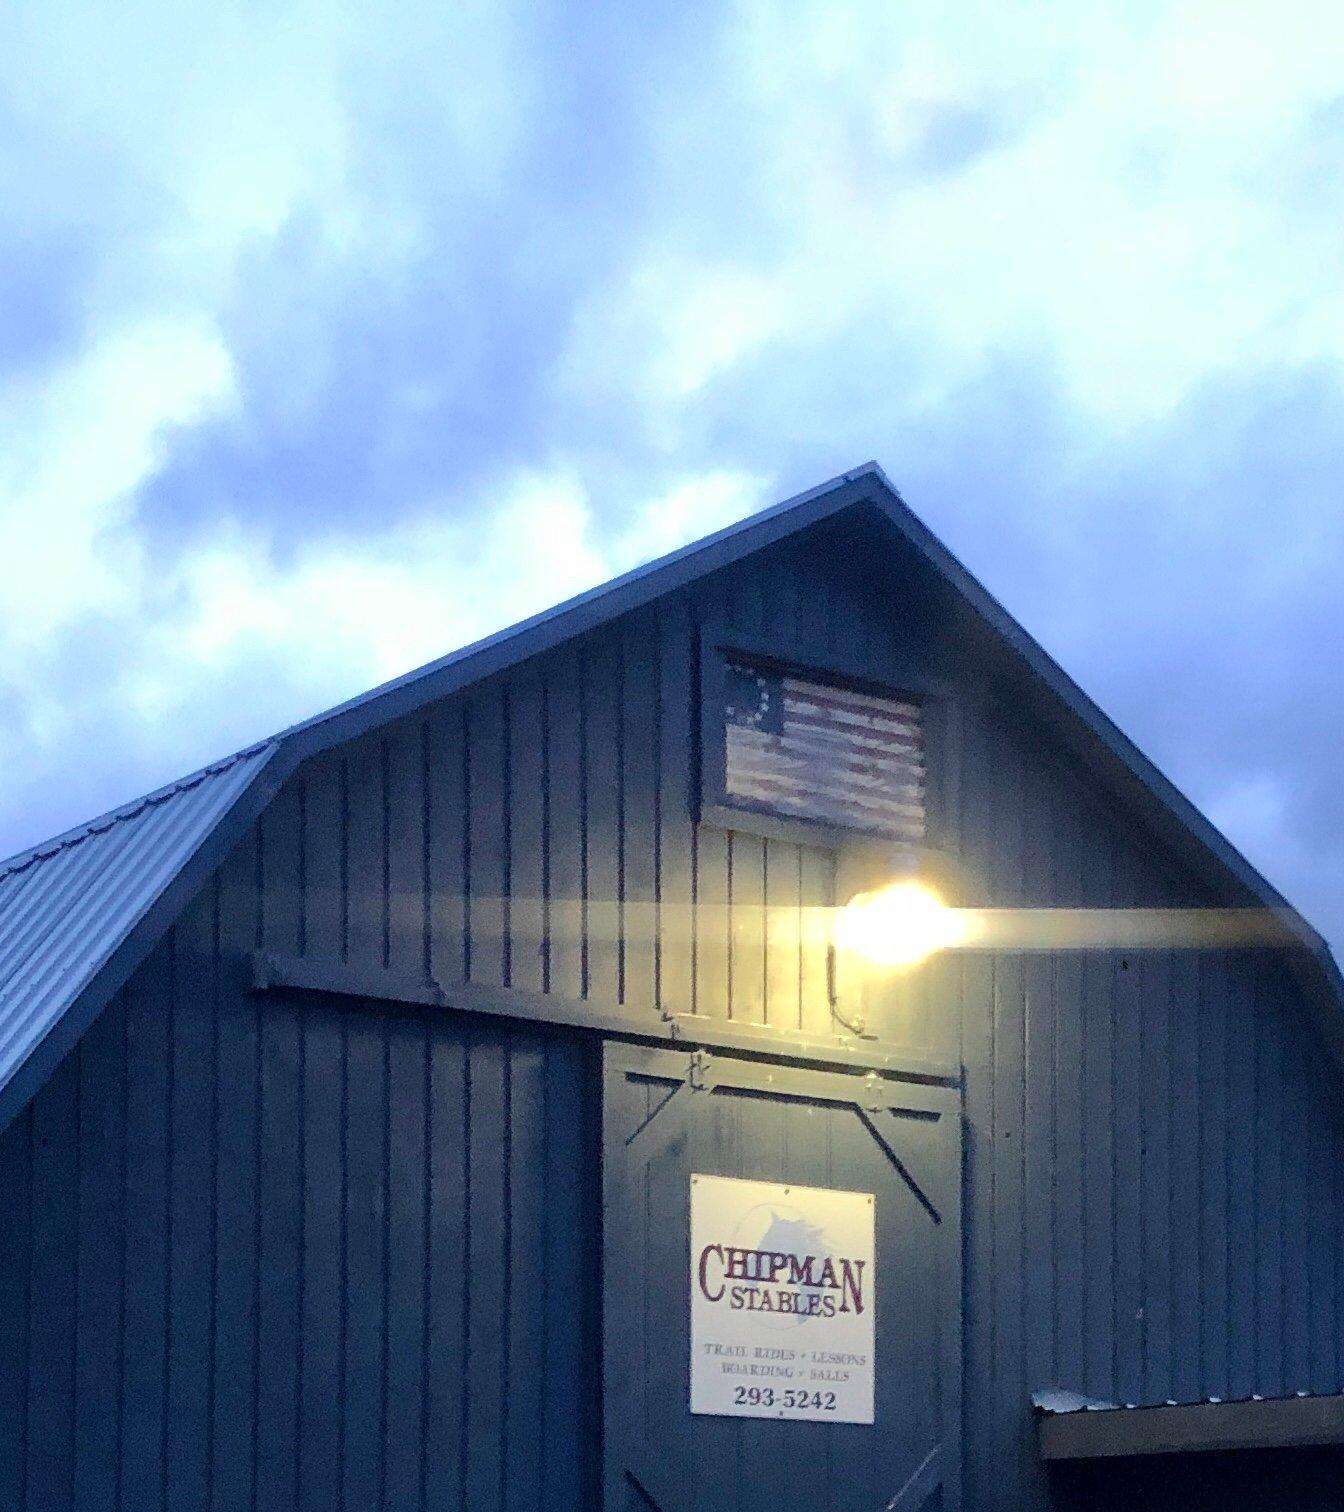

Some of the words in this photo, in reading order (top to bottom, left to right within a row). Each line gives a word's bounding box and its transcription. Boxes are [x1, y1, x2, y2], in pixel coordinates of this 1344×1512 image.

[698, 1243, 866, 1315] CHIPMAN
[730, 1286, 837, 1318] STABLES
[704, 1343, 749, 1358] TRAIL
[753, 1346, 796, 1361] RIDES
[810, 1350, 866, 1367] LESSONS
[720, 1361, 794, 1379] BOARDING
[809, 1369, 850, 1382] SALES
[734, 1385, 837, 1411] 293-5242
